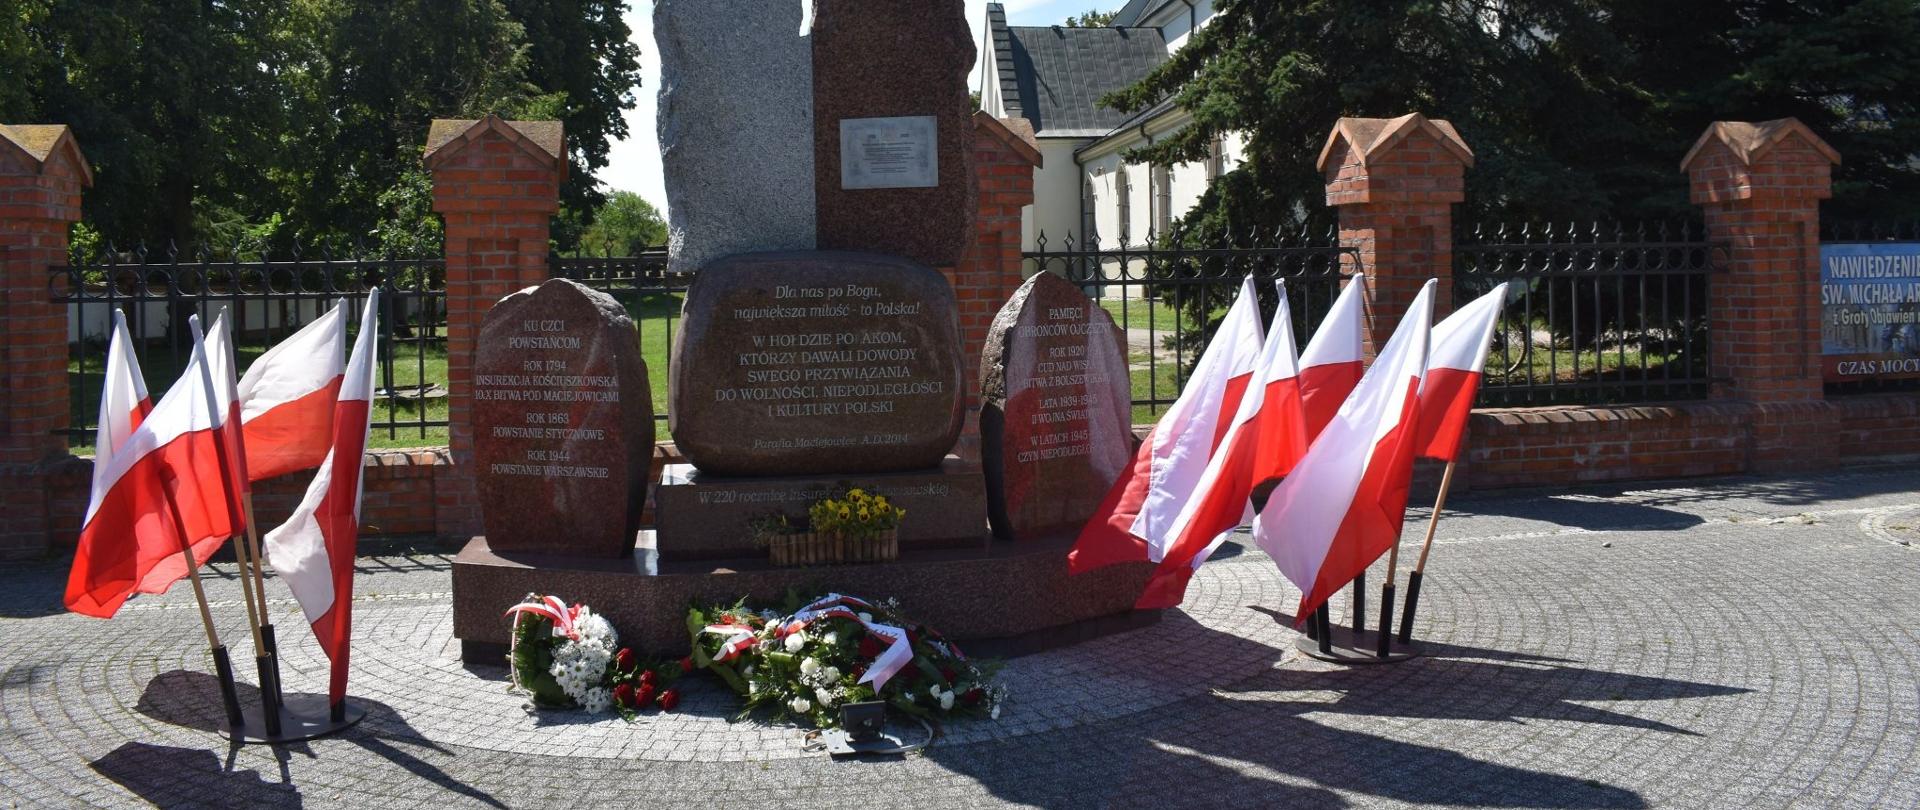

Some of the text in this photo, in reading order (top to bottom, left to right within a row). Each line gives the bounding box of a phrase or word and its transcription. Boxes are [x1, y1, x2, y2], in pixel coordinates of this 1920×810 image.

[775, 284, 882, 300] Dla nas po Bogu,
[1822, 279, 1846, 305] ŚW.
[1849, 283, 1904, 305] MICHAŁA
[734, 304, 806, 322] największa
[810, 303, 850, 317] miłość
[860, 303, 873, 316] to
[876, 302, 921, 315] Polska!
[1049, 307, 1084, 321] PAMIĘCI
[1833, 313, 1839, 325] z
[1841, 308, 1869, 328] Groty
[1870, 306, 1915, 327] Objawień
[524, 319, 565, 332] KU CZCI
[1019, 323, 1068, 338] OBROŃCÓW
[509, 335, 580, 350] POWSTAŃCOM
[752, 332, 907, 347] W HOŁDZIE POAKOM,
[739, 348, 917, 366] KTÓRZY DAWALI DOWODY
[1049, 345, 1085, 358] ROK 1920
[524, 360, 567, 372] ROK 1794
[1038, 359, 1096, 373] CUD NAD WIS
[1837, 358, 1920, 376] CZAS MOCY
[476, 373, 619, 387] INSUREKCJA KOŚCIUSZKOWSKA
[747, 366, 912, 383] SWEGO PRZYWIĄZANIA
[1023, 377, 1047, 389] BITWA
[1049, 376, 1055, 387] Z
[493, 390, 521, 401] BITWA
[523, 390, 541, 401] POD
[543, 390, 620, 402] MACIEJOWICAMI
[715, 388, 736, 402] DO
[823, 380, 943, 398] NIEPODLEGŁOŚCI
[776, 403, 841, 417] KULTURY
[845, 400, 895, 416] POLSKI
[1039, 398, 1058, 409] LATA
[526, 412, 569, 424] ROK 1863
[1031, 414, 1037, 425] II
[1038, 411, 1065, 424] WOJNA
[493, 426, 605, 440] POWSTANIE STYCZNIOWE
[1031, 435, 1039, 446] W
[1039, 432, 1069, 445] LATACH
[527, 450, 570, 462] ROK 1944
[1017, 451, 1039, 463] CZYN
[491, 463, 609, 478] POWSTANIE WARSZAWSKIE
[696, 491, 712, 504] W
[713, 489, 737, 503] 220
